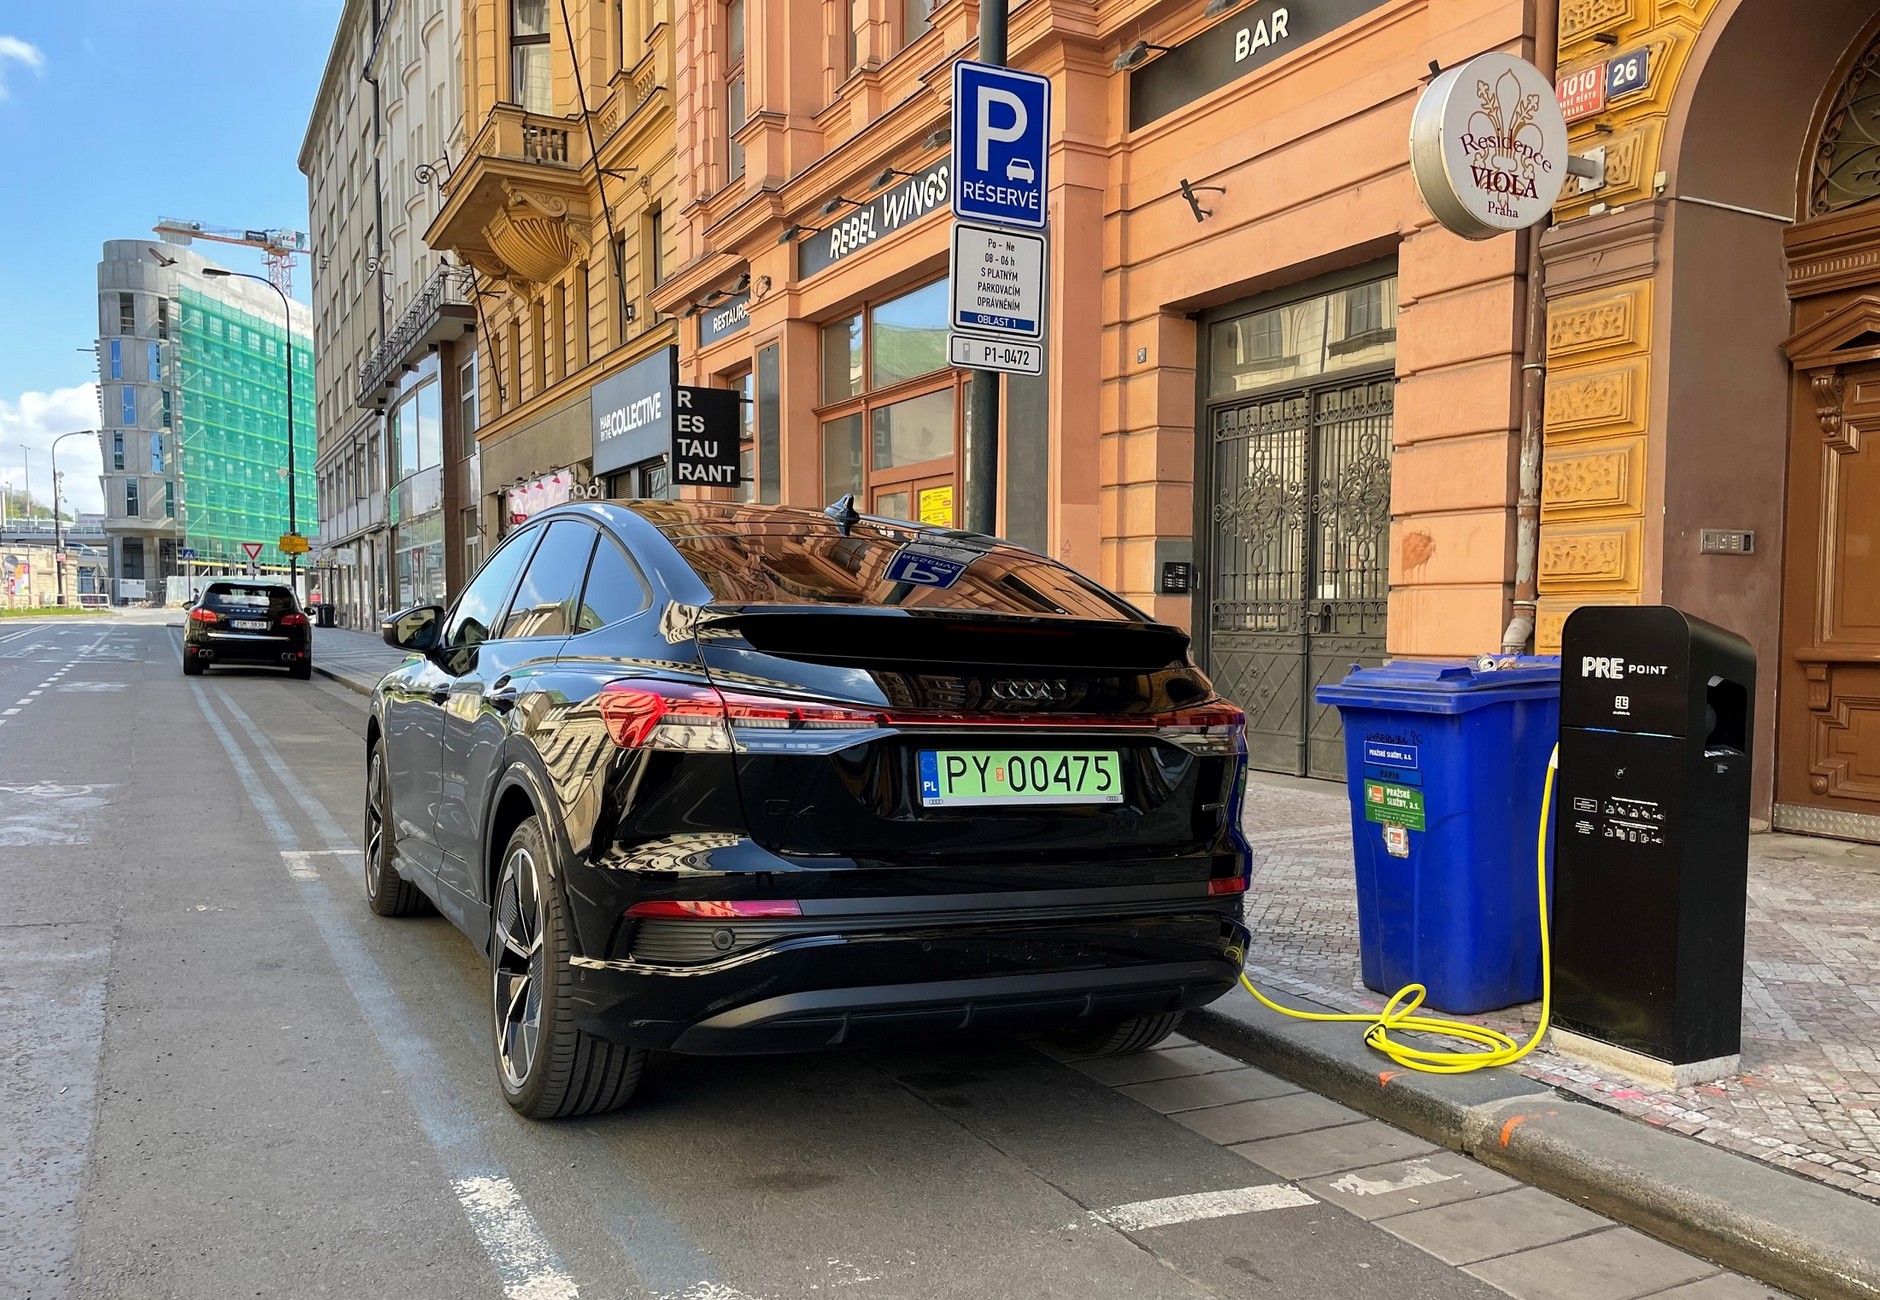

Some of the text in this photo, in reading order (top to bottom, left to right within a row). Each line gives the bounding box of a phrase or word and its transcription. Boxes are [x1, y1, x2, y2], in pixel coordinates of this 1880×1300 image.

[1234, 7, 1289, 63] BAR
[1612, 59, 1637, 87] 26
[1562, 69, 1596, 99] 1010
[976, 85, 1028, 172] P
[1459, 128, 1552, 174] Residence
[1470, 165, 1539, 200] VIOLA
[963, 180, 1039, 210] RÉSERVÉ
[829, 165, 949, 260] REBEL WINGS
[1487, 200, 1519, 219] Praha
[988, 239, 997, 248] Po
[1006, 241, 1015, 252] Ne
[985, 253, 994, 263] 08
[1000, 255, 1009, 266] 06
[1010, 256, 1015, 267] h
[981, 267, 1018, 281] S PLATNÝM
[977, 281, 1021, 297] PARKOVACÍM
[977, 296, 1021, 312] OPRÁVNĚNÍM
[977, 314, 1017, 328] OBLAST 1
[984, 346, 1030, 366] P1-0472
[677, 390, 693, 409] R
[611, 391, 662, 437] COLLECTIVE
[677, 414, 705, 434] ES
[677, 438, 718, 459] TAU
[678, 462, 736, 483] RANT
[1582, 656, 1668, 679] PRE POINT
[946, 755, 1112, 794] PY 00475
[924, 781, 937, 792] PL
